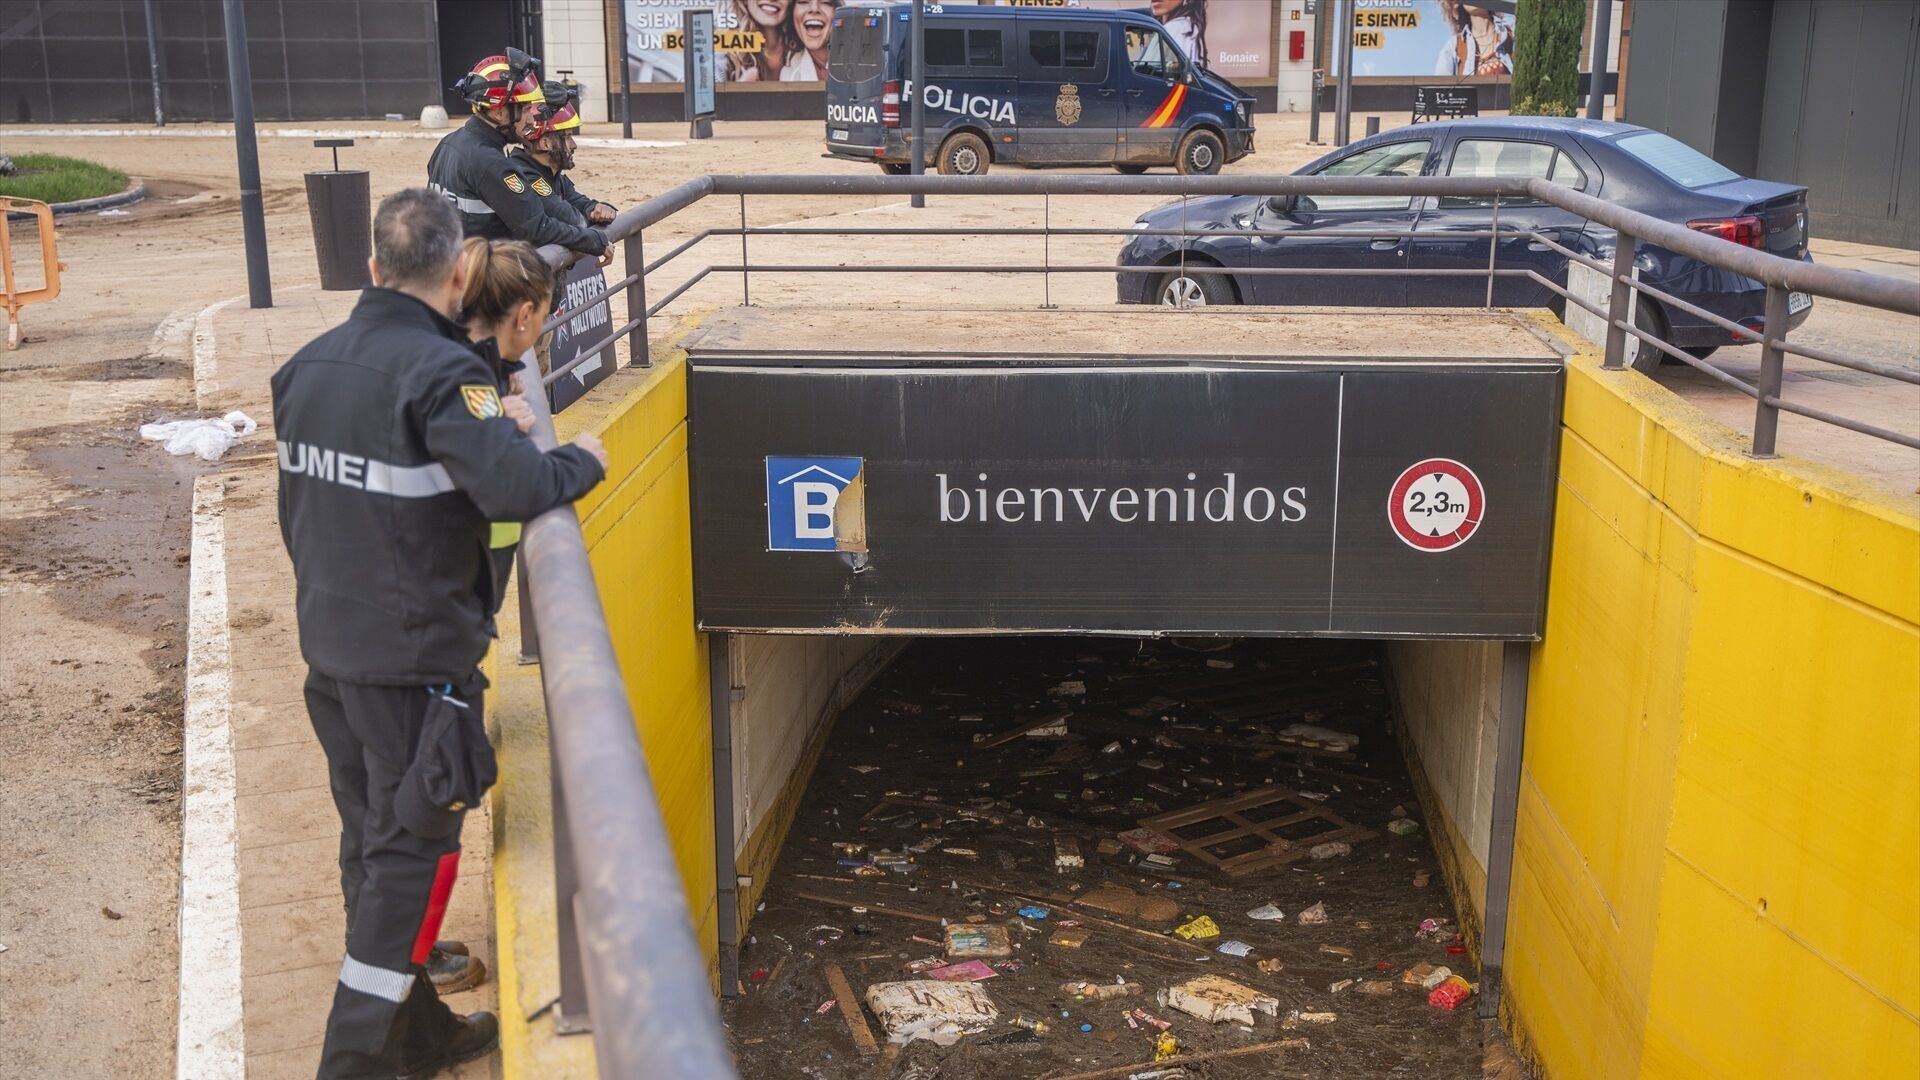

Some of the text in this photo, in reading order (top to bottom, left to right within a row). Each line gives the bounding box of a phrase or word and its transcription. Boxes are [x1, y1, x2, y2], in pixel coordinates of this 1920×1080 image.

[1367, 14, 1417, 27] SIENTA
[637, 34, 662, 49] UN
[1353, 33, 1378, 46] IEN
[1219, 51, 1260, 63] Bonaire
[827, 104, 878, 123] POLICIA
[902, 79, 1016, 124] POLICIA
[566, 273, 605, 310] FOSTER'S
[277, 440, 365, 489] UME
[793, 481, 839, 539] B
[935, 472, 1308, 522] bienvenidos
[1409, 491, 1465, 517] 2,3m
